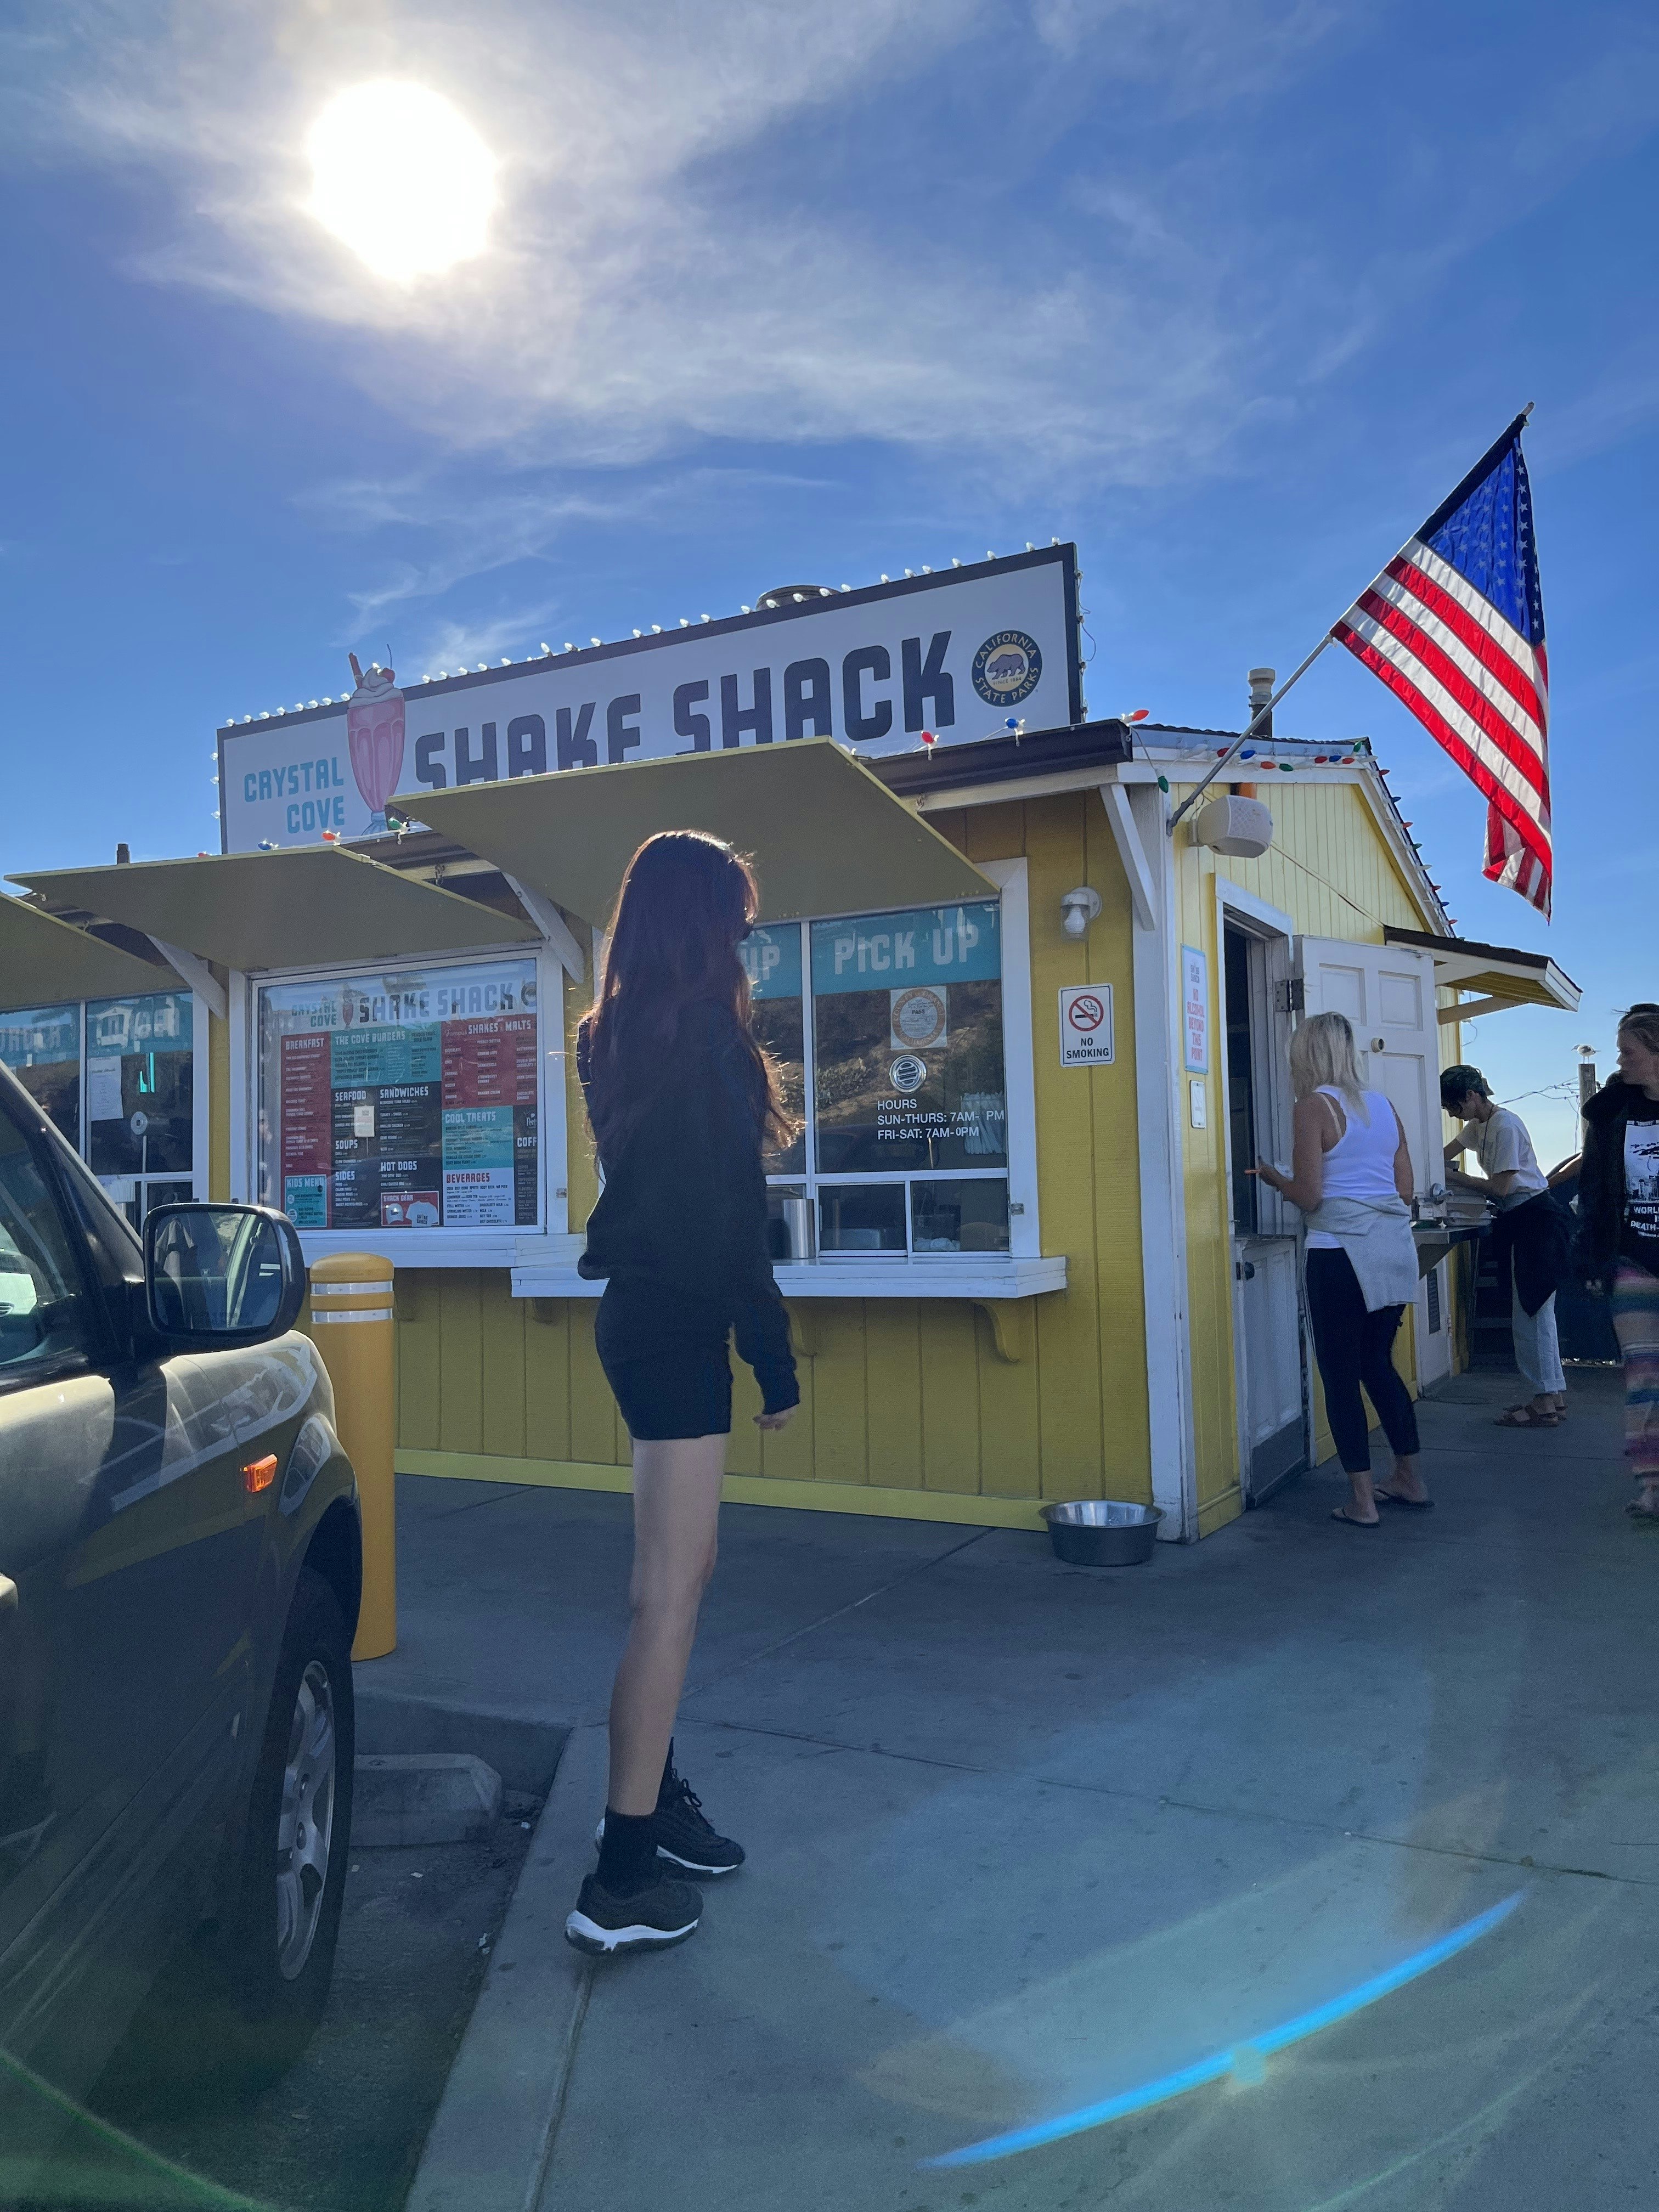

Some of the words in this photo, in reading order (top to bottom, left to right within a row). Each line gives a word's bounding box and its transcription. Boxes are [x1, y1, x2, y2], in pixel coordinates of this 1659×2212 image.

[975, 633, 1036, 668] CALIFORNIA
[975, 678, 1006, 703] STATE
[1012, 668, 1039, 701] PARKS
[415, 693, 641, 789] SHAKE
[673, 630, 955, 755] SHACK
[244, 757, 344, 803] CRYSTAL
[287, 795, 345, 834] COVE
[834, 931, 915, 975] PICK
[933, 924, 979, 965] UP
[359, 991, 430, 1024] SHAKE
[438, 983, 514, 1017] SHACK
[1187, 1001, 1205, 1018] ALCOHOL
[311, 1014, 336, 1027] COVE
[468, 1023, 498, 1034] SHAKES
[505, 1020, 531, 1031] MALTS
[1188, 1018, 1204, 1032] BEYOND
[286, 1038, 324, 1050] BREAKFAST
[335, 1035, 349, 1045] THE
[351, 1033, 370, 1044] COVE
[372, 1030, 405, 1042] BURGERS
[1081, 1037, 1093, 1046] NO
[1192, 1032, 1201, 1046] THIS
[1066, 1047, 1109, 1059] SMOKING
[1191, 1047, 1203, 1061] POINT
[335, 1090, 366, 1102] SEAFOOD
[380, 1086, 428, 1098] SANDWICHES
[877, 1099, 917, 1110] HOURS
[445, 1113, 465, 1124] COOL
[466, 1111, 496, 1122] TREATS
[877, 1112, 947, 1125] SUN-THURS:
[950, 1111, 980, 1122] 7AM-
[986, 1110, 1005, 1121] PM
[878, 1128, 922, 1140] FRI-SAT:
[335, 1139, 358, 1149] SOUPS
[381, 1161, 396, 1171] HOT
[398, 1160, 417, 1171] DOGS
[335, 1170, 355, 1181] SIDES
[446, 1172, 490, 1183] BEVERAGES
[287, 1178, 302, 1188] KIDS
[304, 1177, 324, 1187] MENU
